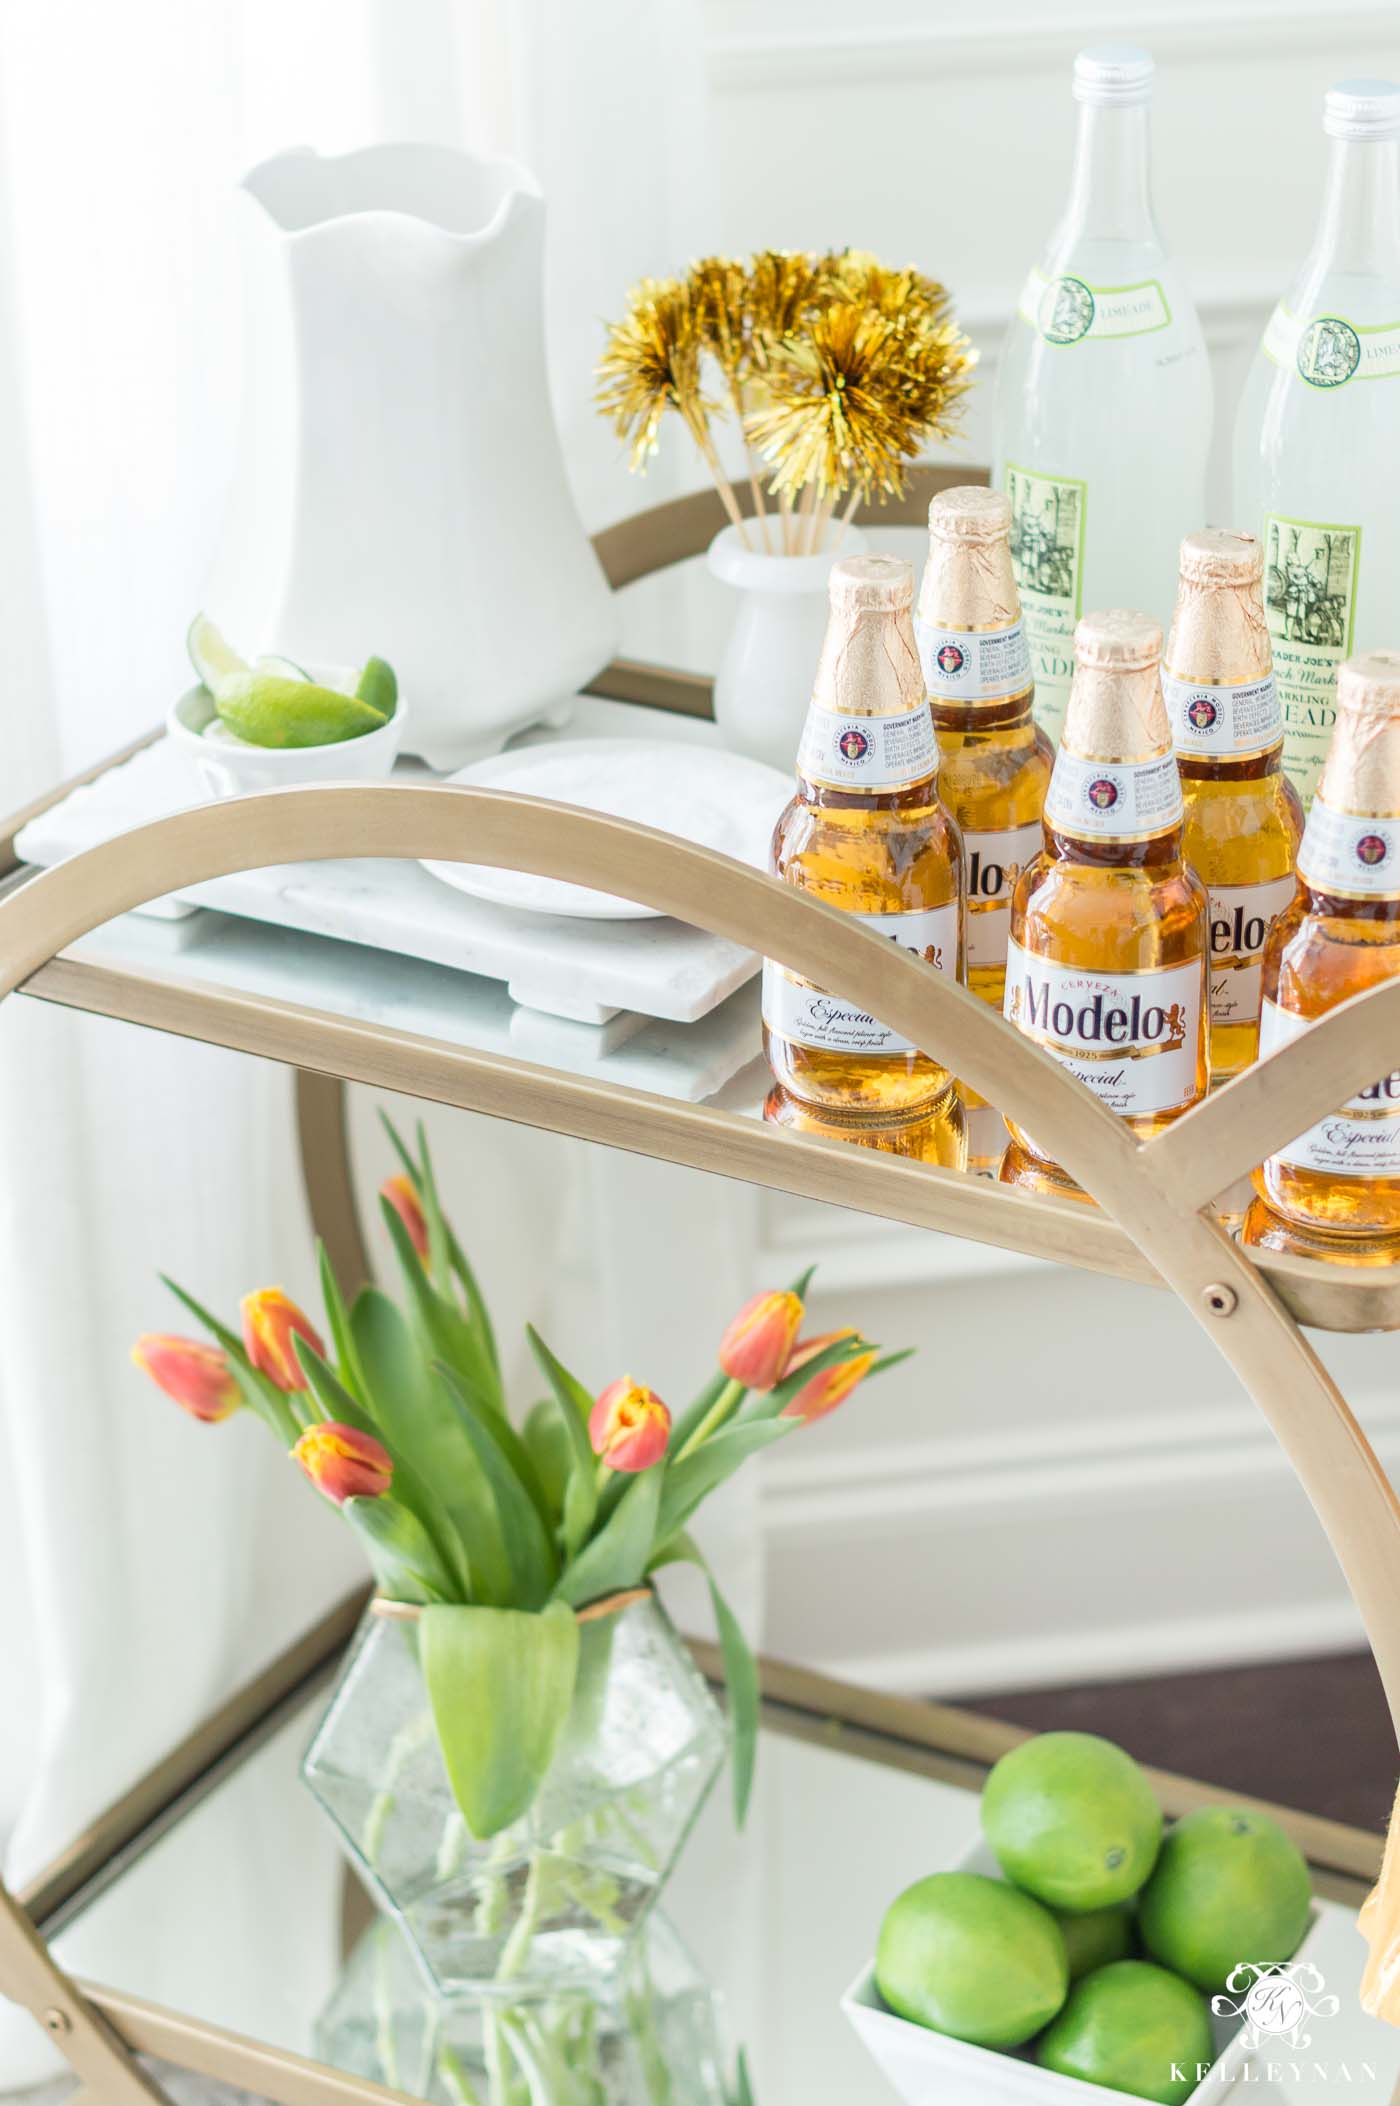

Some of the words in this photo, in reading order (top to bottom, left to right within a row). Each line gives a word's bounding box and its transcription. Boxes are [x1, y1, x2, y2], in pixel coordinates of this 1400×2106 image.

[1061, 980, 1120, 998] CERVEZA
[1024, 974, 1165, 1042] Modelo
[1074, 1050, 1098, 1060] 1925
